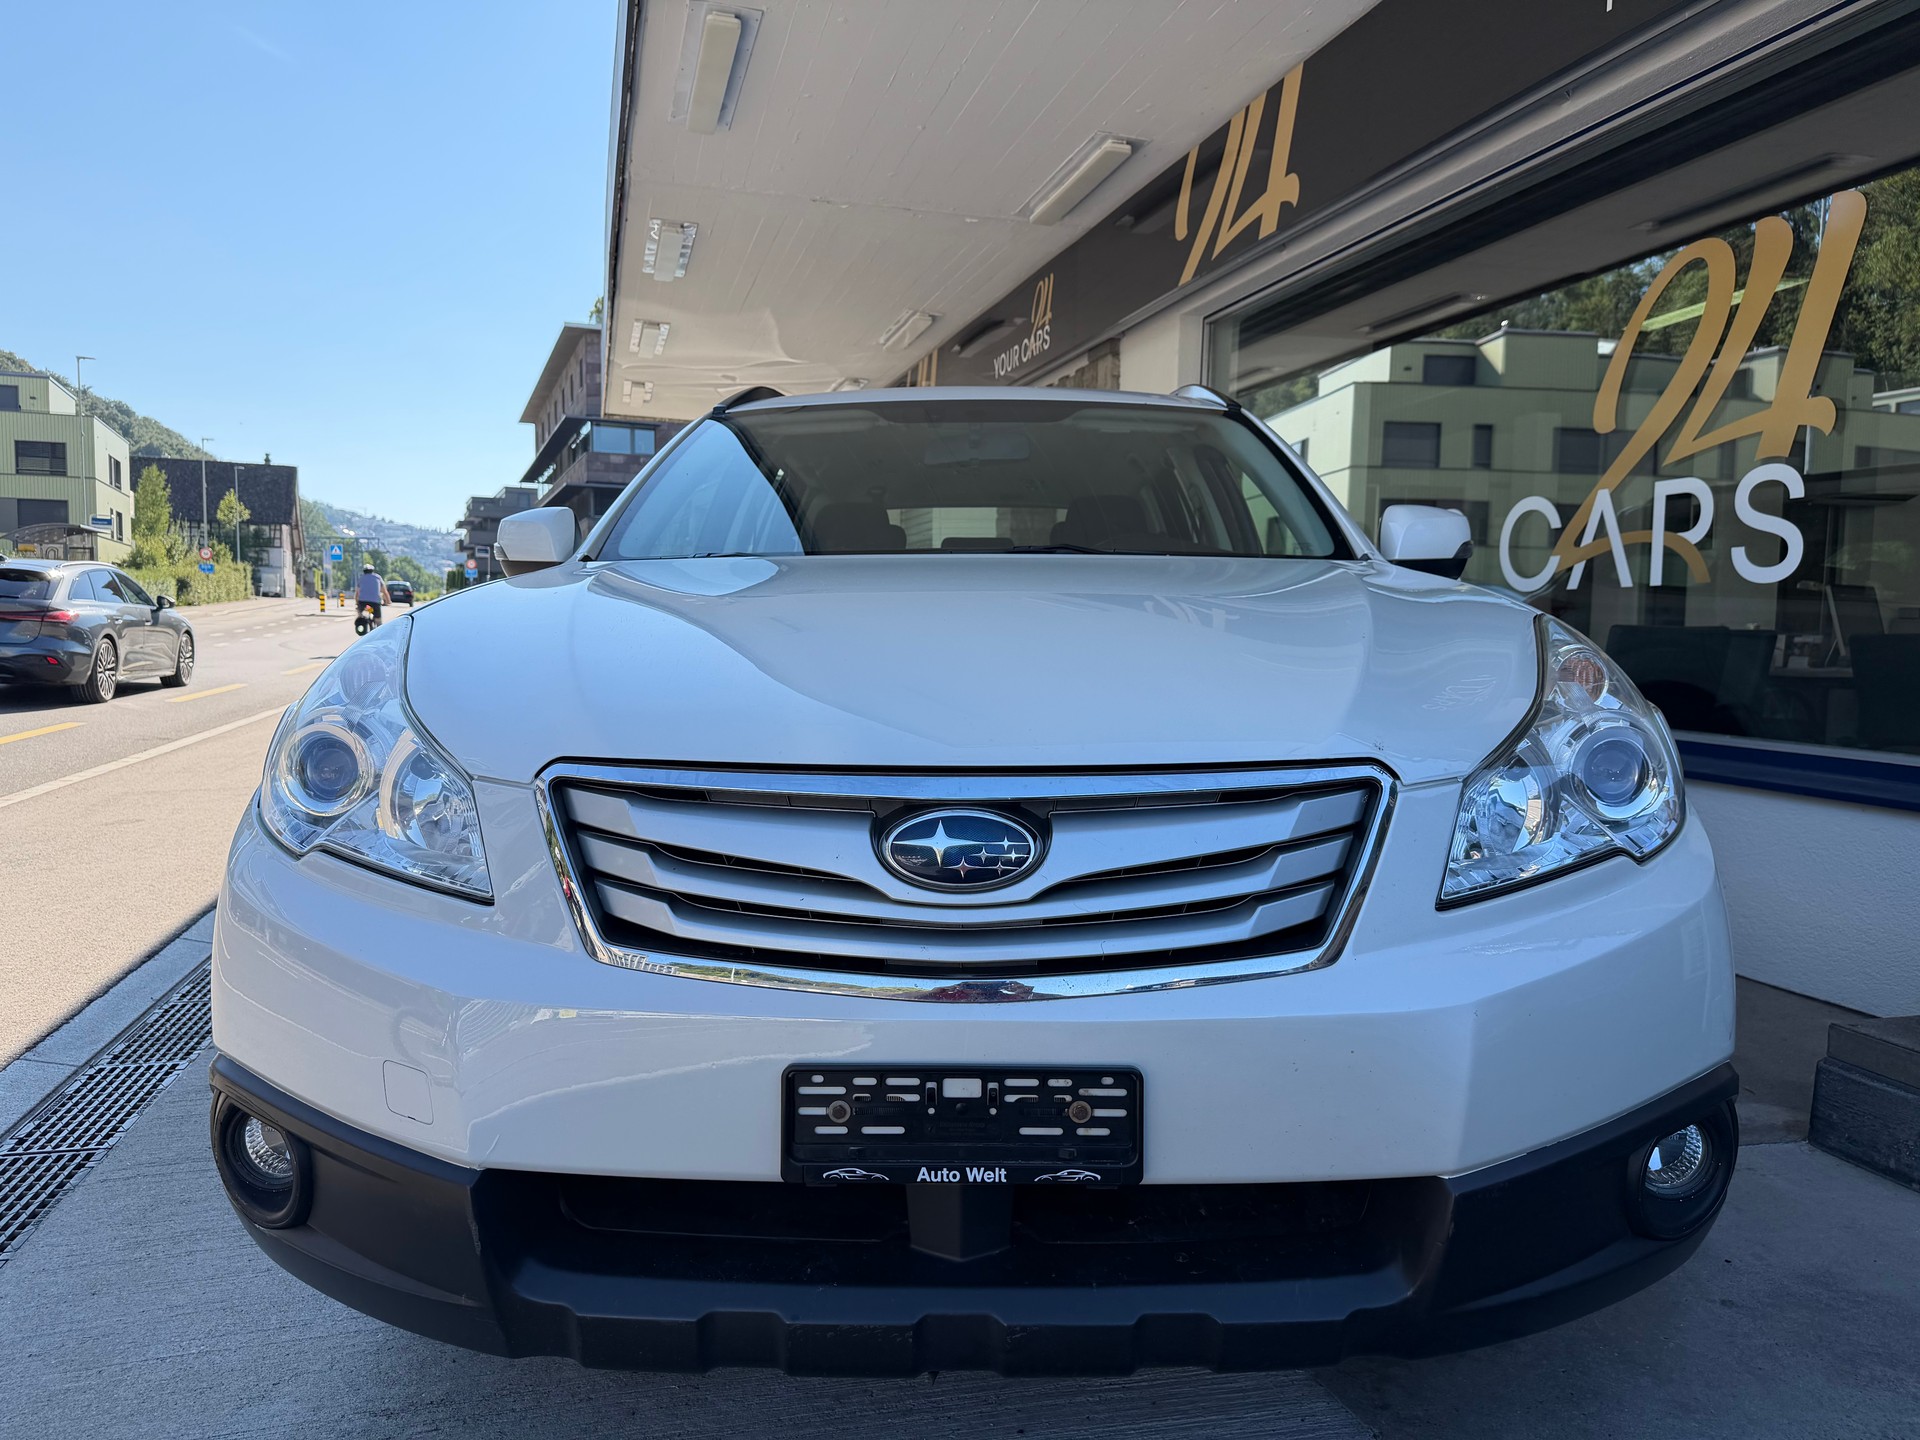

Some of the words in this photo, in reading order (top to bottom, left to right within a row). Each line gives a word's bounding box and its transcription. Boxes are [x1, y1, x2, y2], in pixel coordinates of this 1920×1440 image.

[993, 344, 1020, 379] YOUR
[1021, 325, 1051, 362] CARS
[1499, 463, 1806, 592] CARS
[916, 1166, 961, 1183] Auto
[965, 1167, 1007, 1183] Welt
